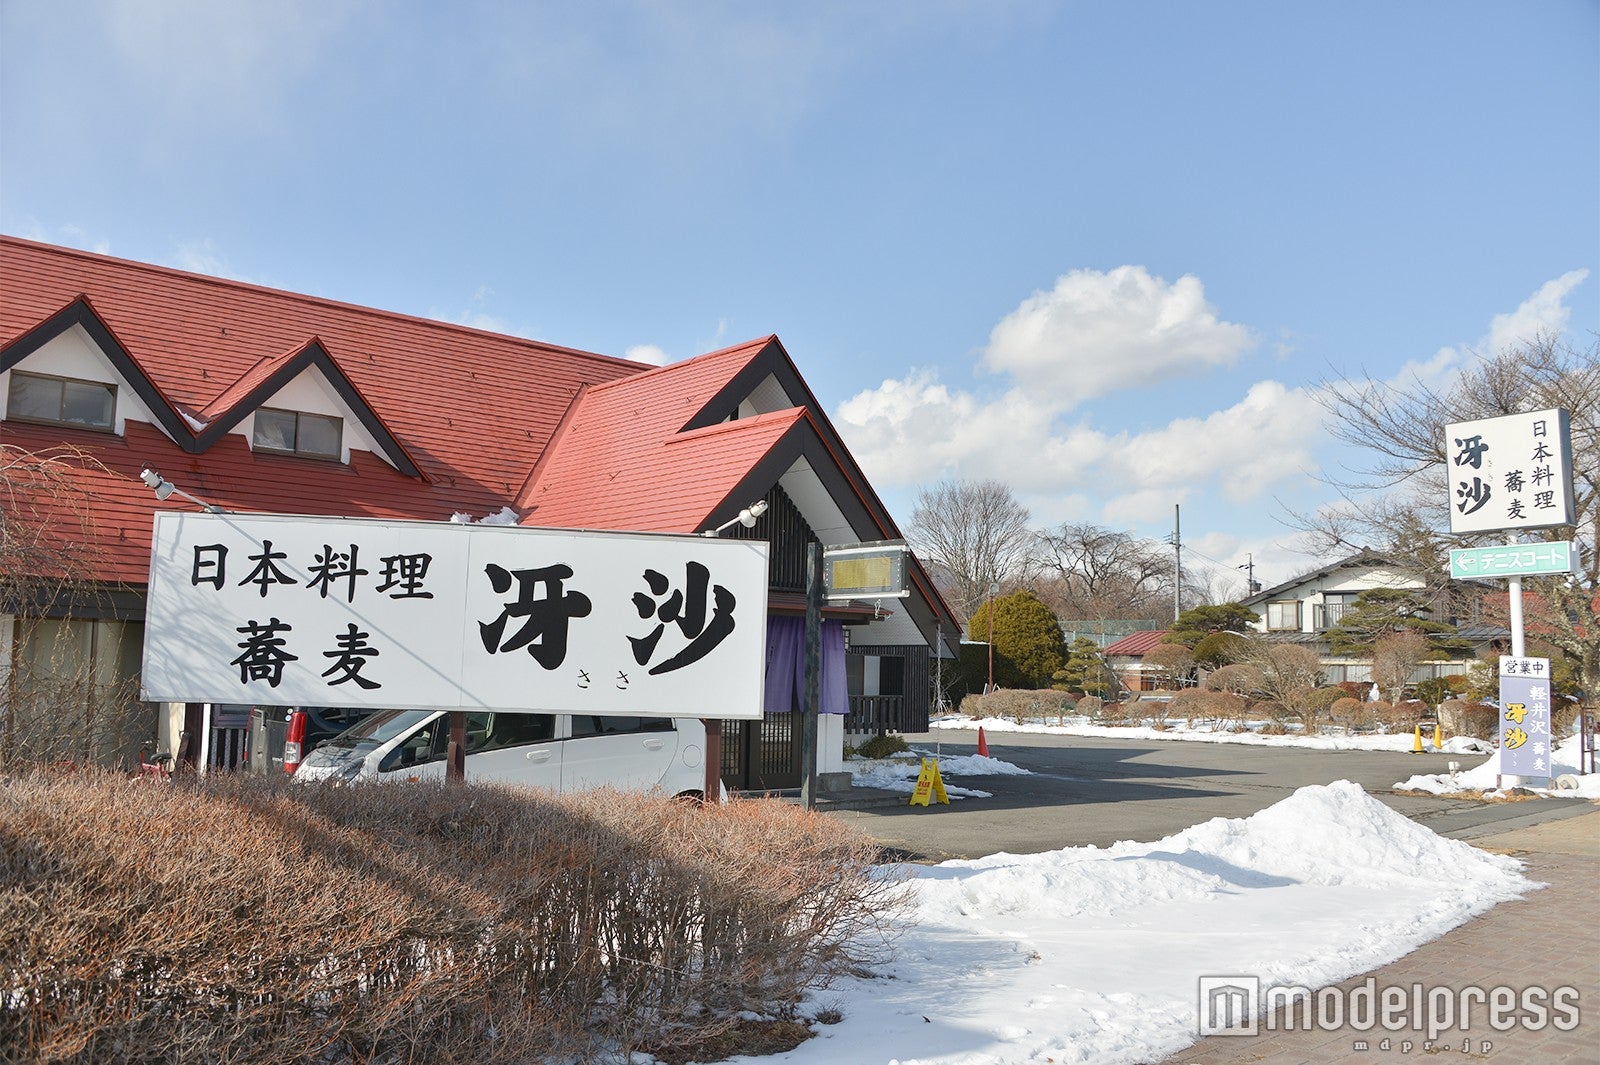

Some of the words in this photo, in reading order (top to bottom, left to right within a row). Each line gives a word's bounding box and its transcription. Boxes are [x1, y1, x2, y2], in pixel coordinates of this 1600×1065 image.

[1531, 420, 1556, 510] 日本料理
[1504, 469, 1527, 520] 蕎麦
[191, 539, 434, 604] 日本料理
[1481, 548, 1565, 571] テニスコート
[229, 617, 382, 690] 蕎麦
[1505, 660, 1544, 675] 営業中
